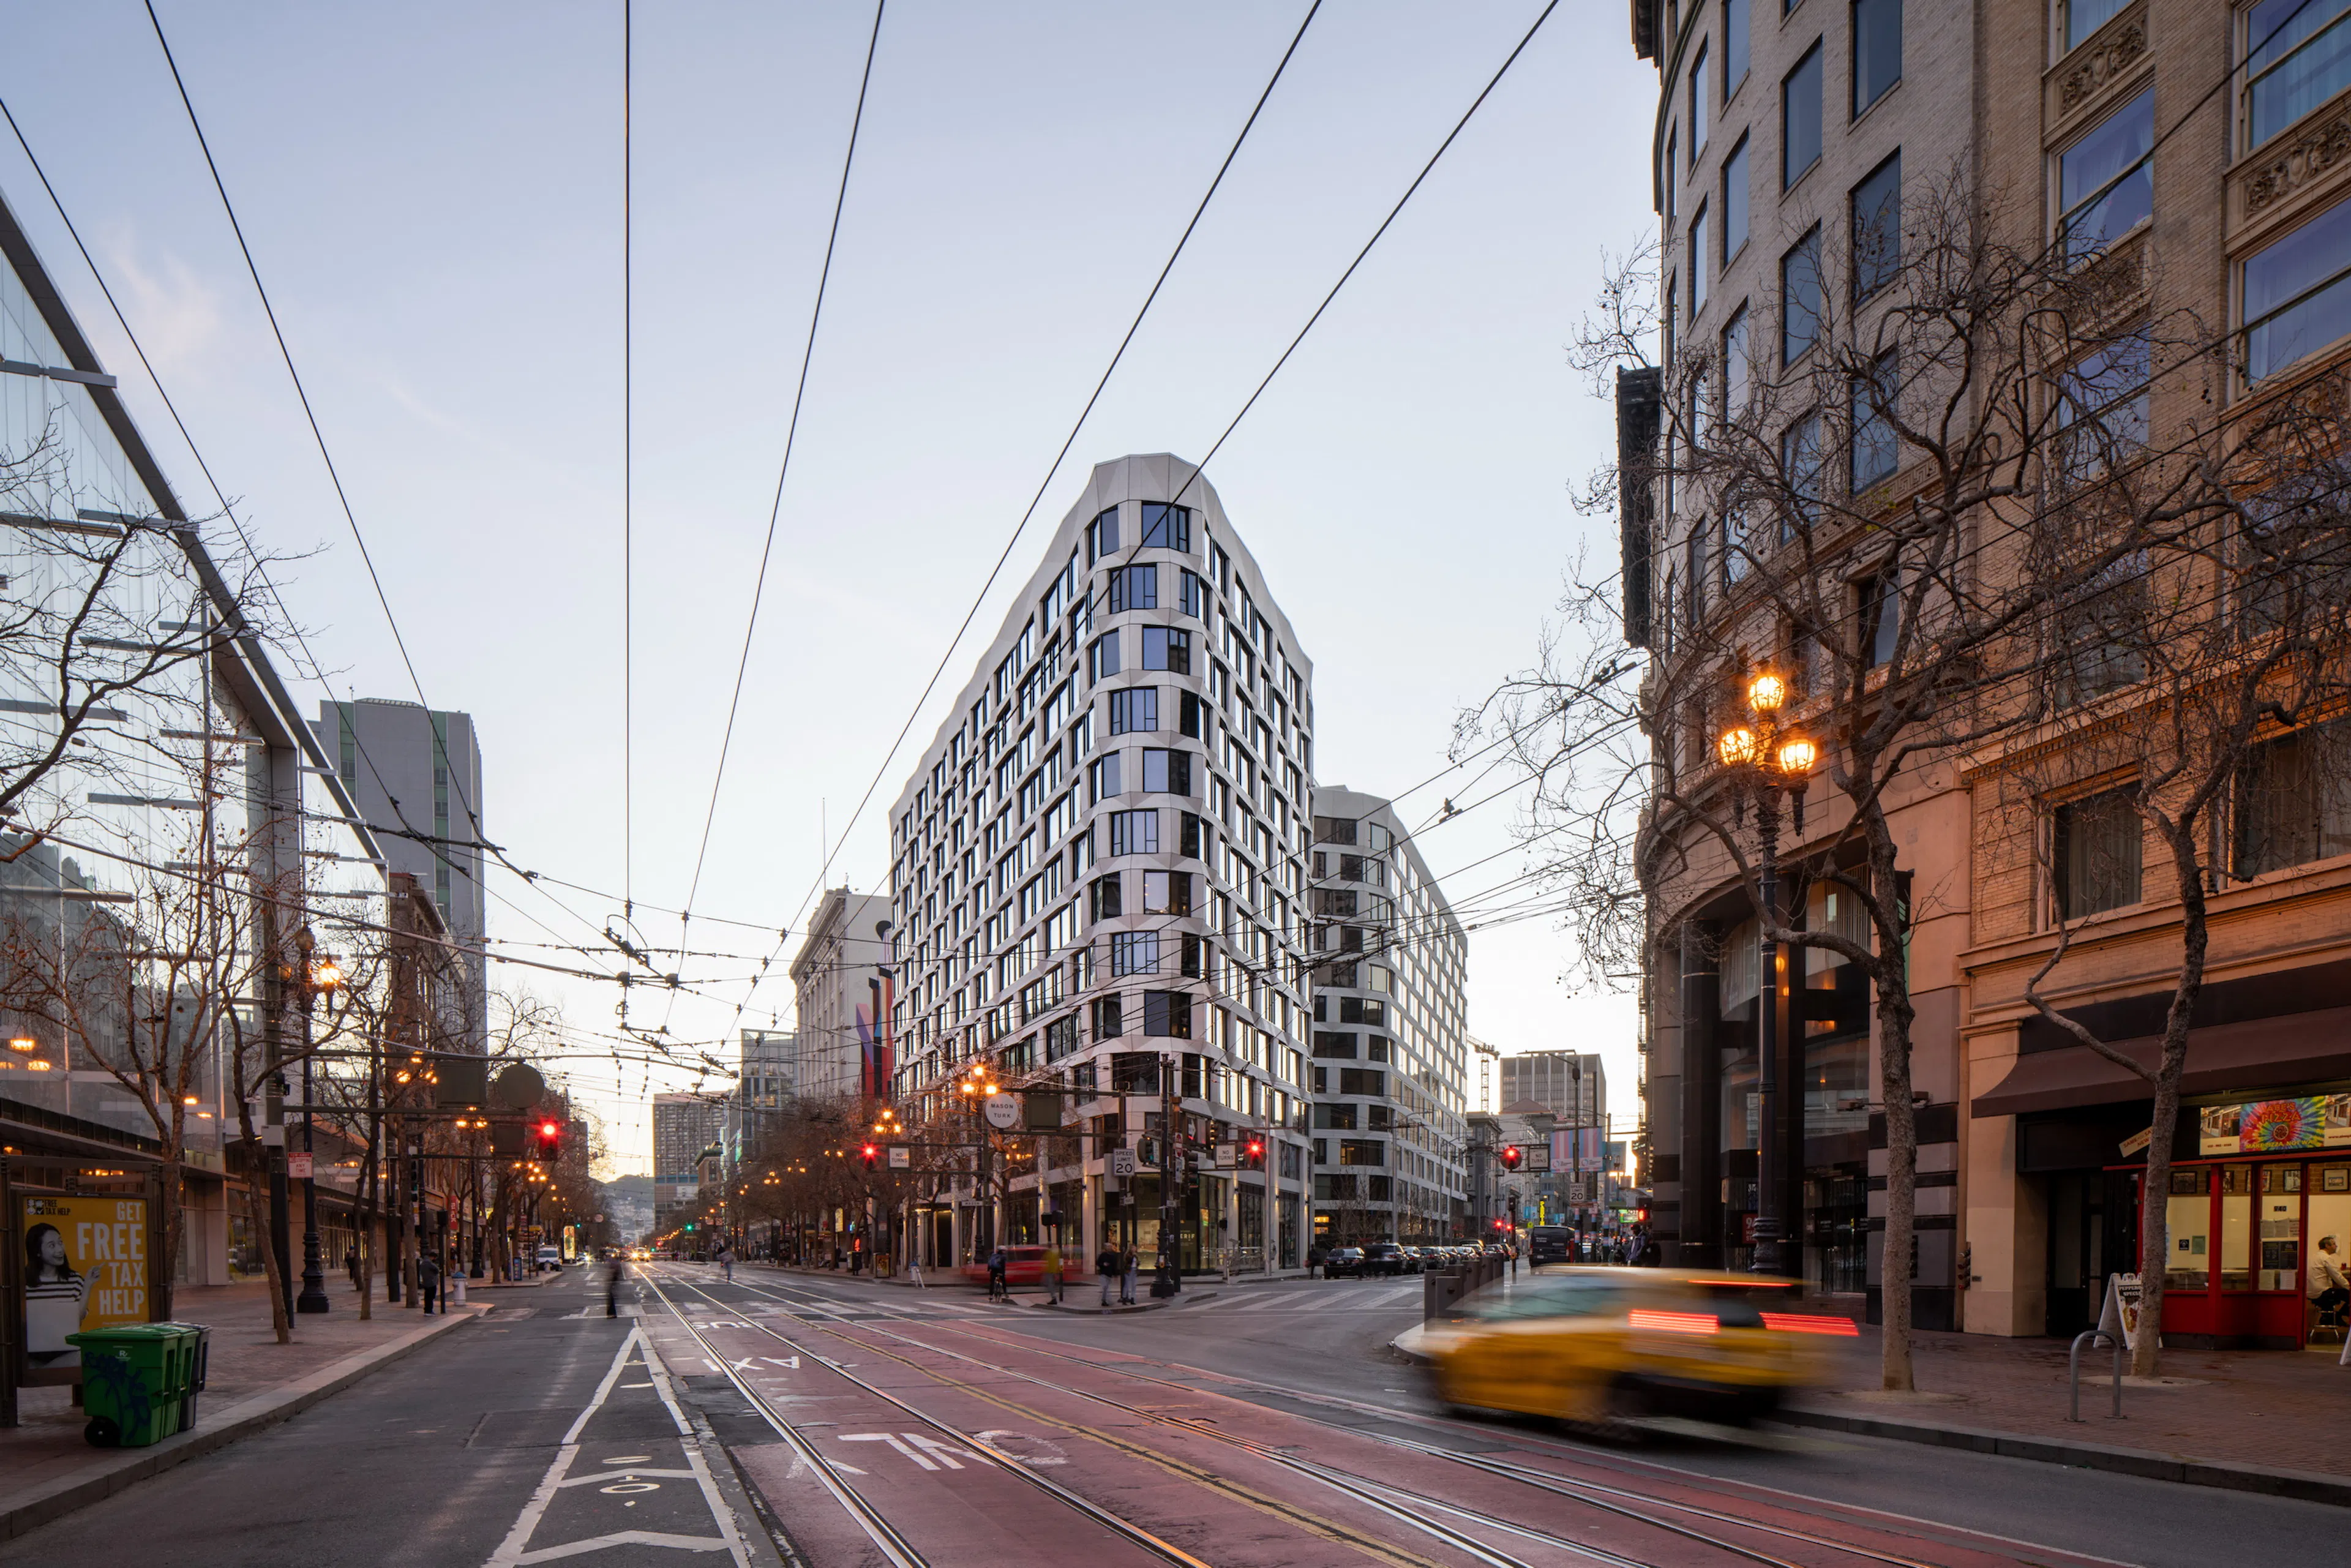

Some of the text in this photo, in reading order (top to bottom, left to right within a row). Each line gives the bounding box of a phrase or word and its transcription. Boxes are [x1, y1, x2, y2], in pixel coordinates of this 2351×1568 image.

[2261, 1110, 2301, 1123] PIZZA
[1116, 1163, 1133, 1173] 20
[117, 1202, 142, 1221] GET
[77, 1223, 144, 1261] FREE
[108, 1262, 144, 1287] TAX
[99, 1289, 144, 1316] HELP
[786, 1429, 1070, 1479] ONLY
